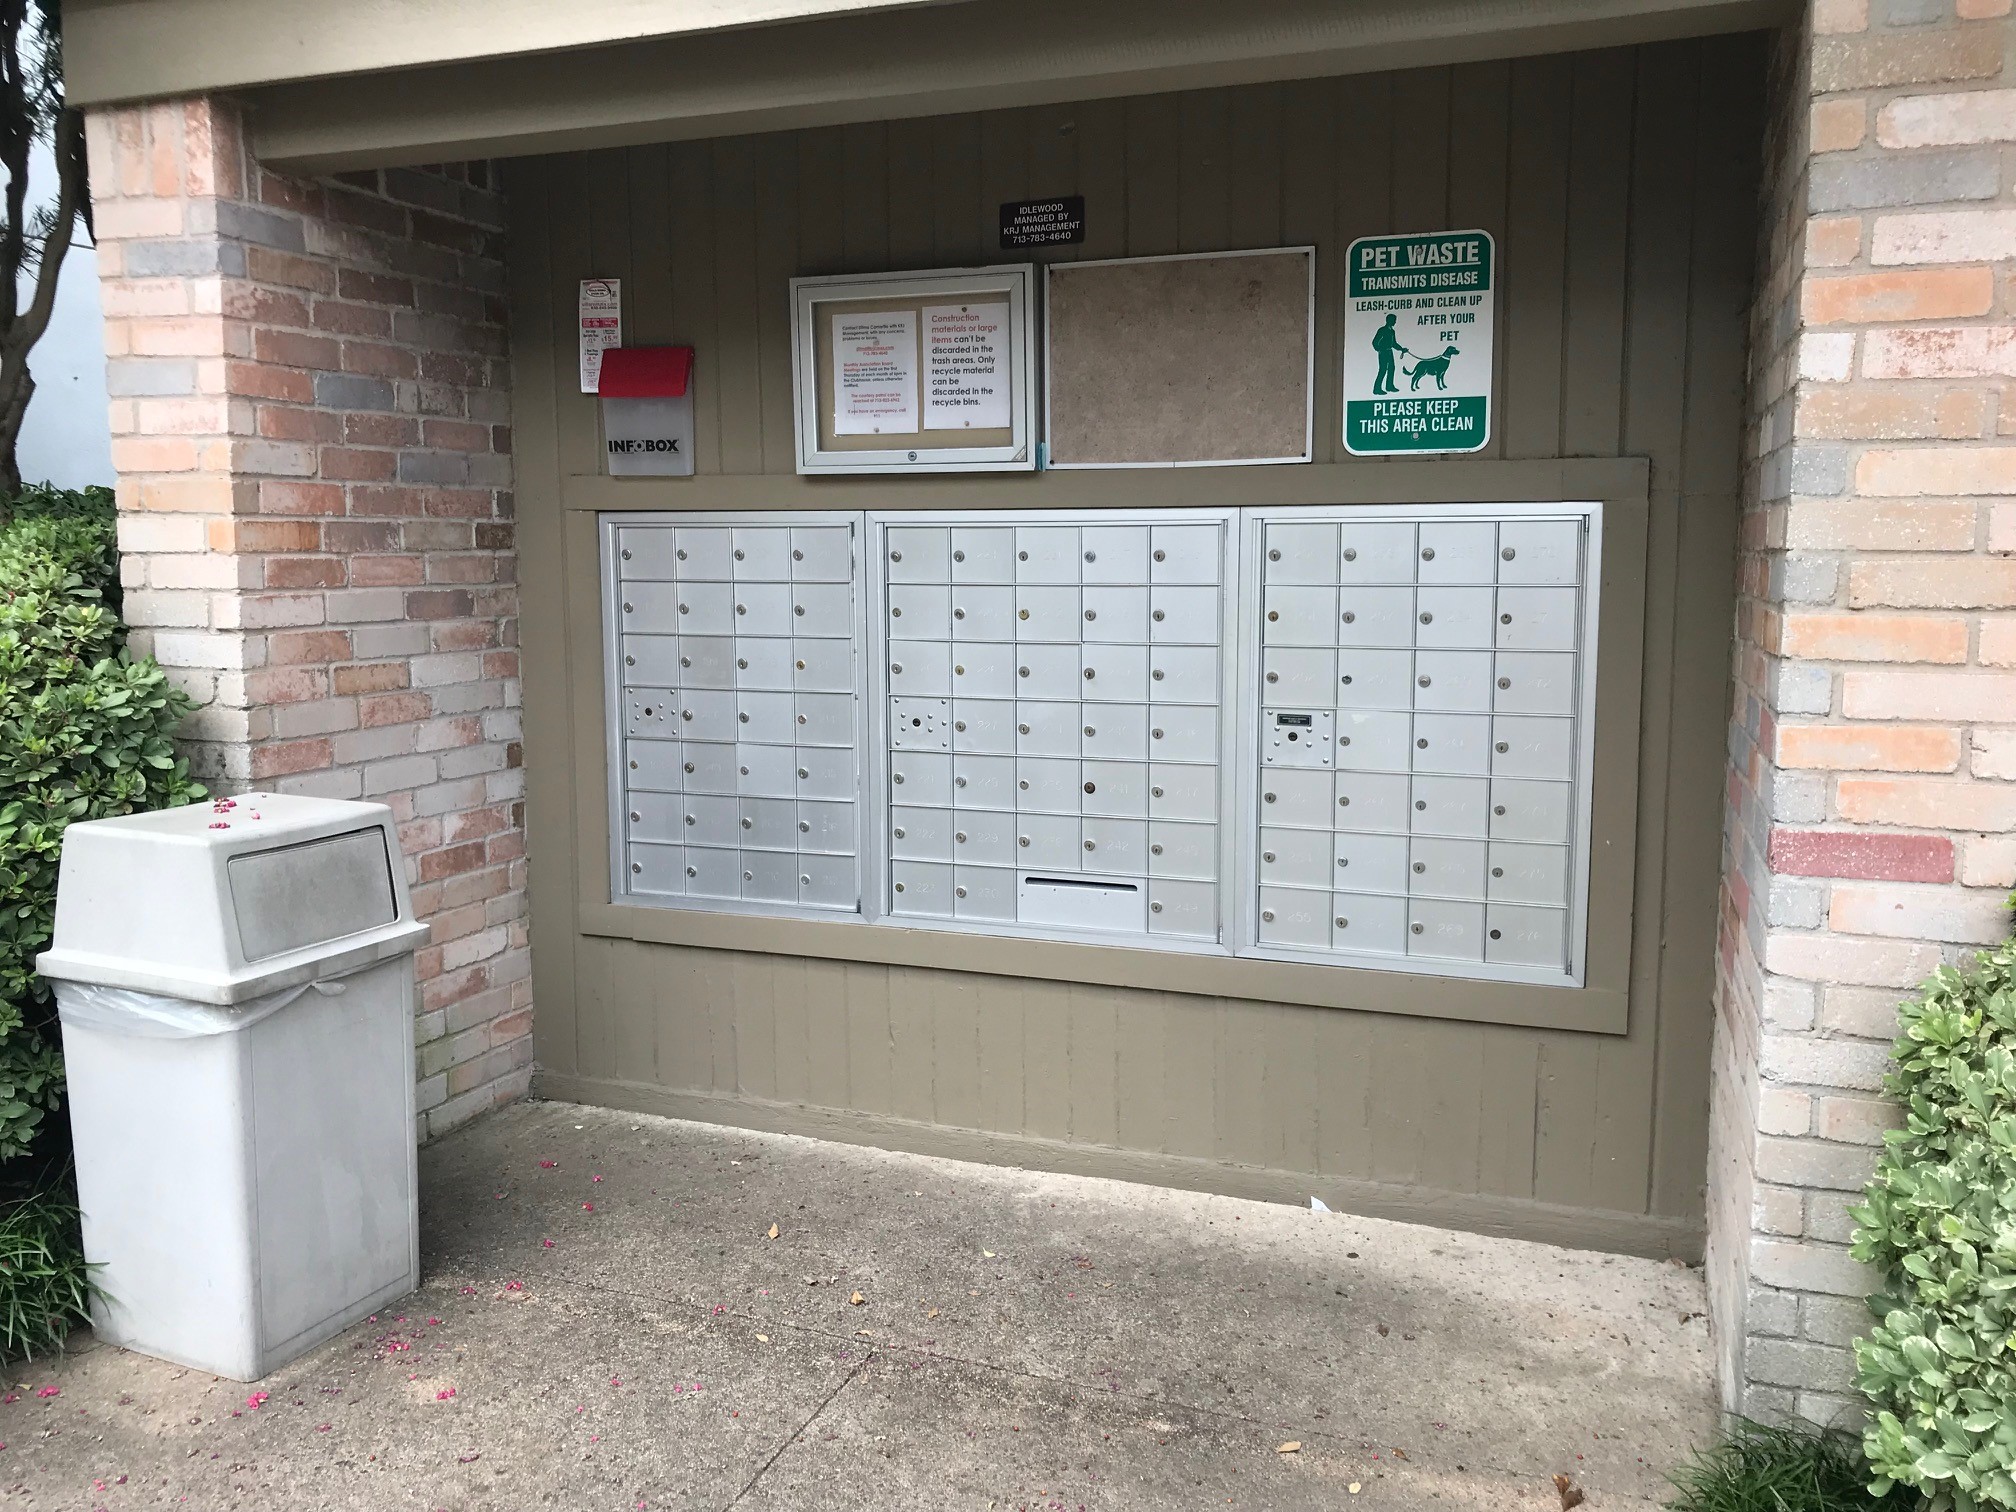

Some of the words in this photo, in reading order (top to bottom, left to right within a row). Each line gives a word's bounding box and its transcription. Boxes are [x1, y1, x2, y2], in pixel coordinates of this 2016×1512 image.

[1020, 204, 1063, 214] IDLEWOOD
[1014, 214, 1054, 224] MANAGED
[1058, 213, 1069, 221] BY
[1023, 221, 1080, 233] MANAGEMENT
[1013, 232, 1072, 244] 713-783-4640
[1361, 246, 1400, 268] PET
[1407, 241, 1479, 266] WASTE
[1362, 275, 1426, 290] TRANSMITS
[1430, 272, 1478, 286] DISEASE
[1356, 298, 1412, 312] LEASH-CURB
[1415, 298, 1434, 308] AND
[1437, 296, 1467, 307] CLEAN
[1470, 295, 1482, 306] UP
[932, 314, 980, 322] Construction
[1417, 315, 1446, 326] AFTER
[1449, 313, 1475, 324] YOUR
[931, 325, 966, 333] materials
[977, 325, 997, 333] large
[1440, 331, 1459, 341] PET
[932, 346, 970, 354] discarded
[977, 356, 996, 364] Only
[932, 367, 961, 376] recycle
[932, 399, 961, 407] recycle
[1374, 402, 1421, 416] PLEASE
[1426, 400, 1459, 414] KEEP
[1360, 419, 1388, 433] THIS
[1393, 418, 1427, 432] AREA
[1431, 416, 1474, 431] CLEAN
[608, 439, 679, 452] INFOBOX
